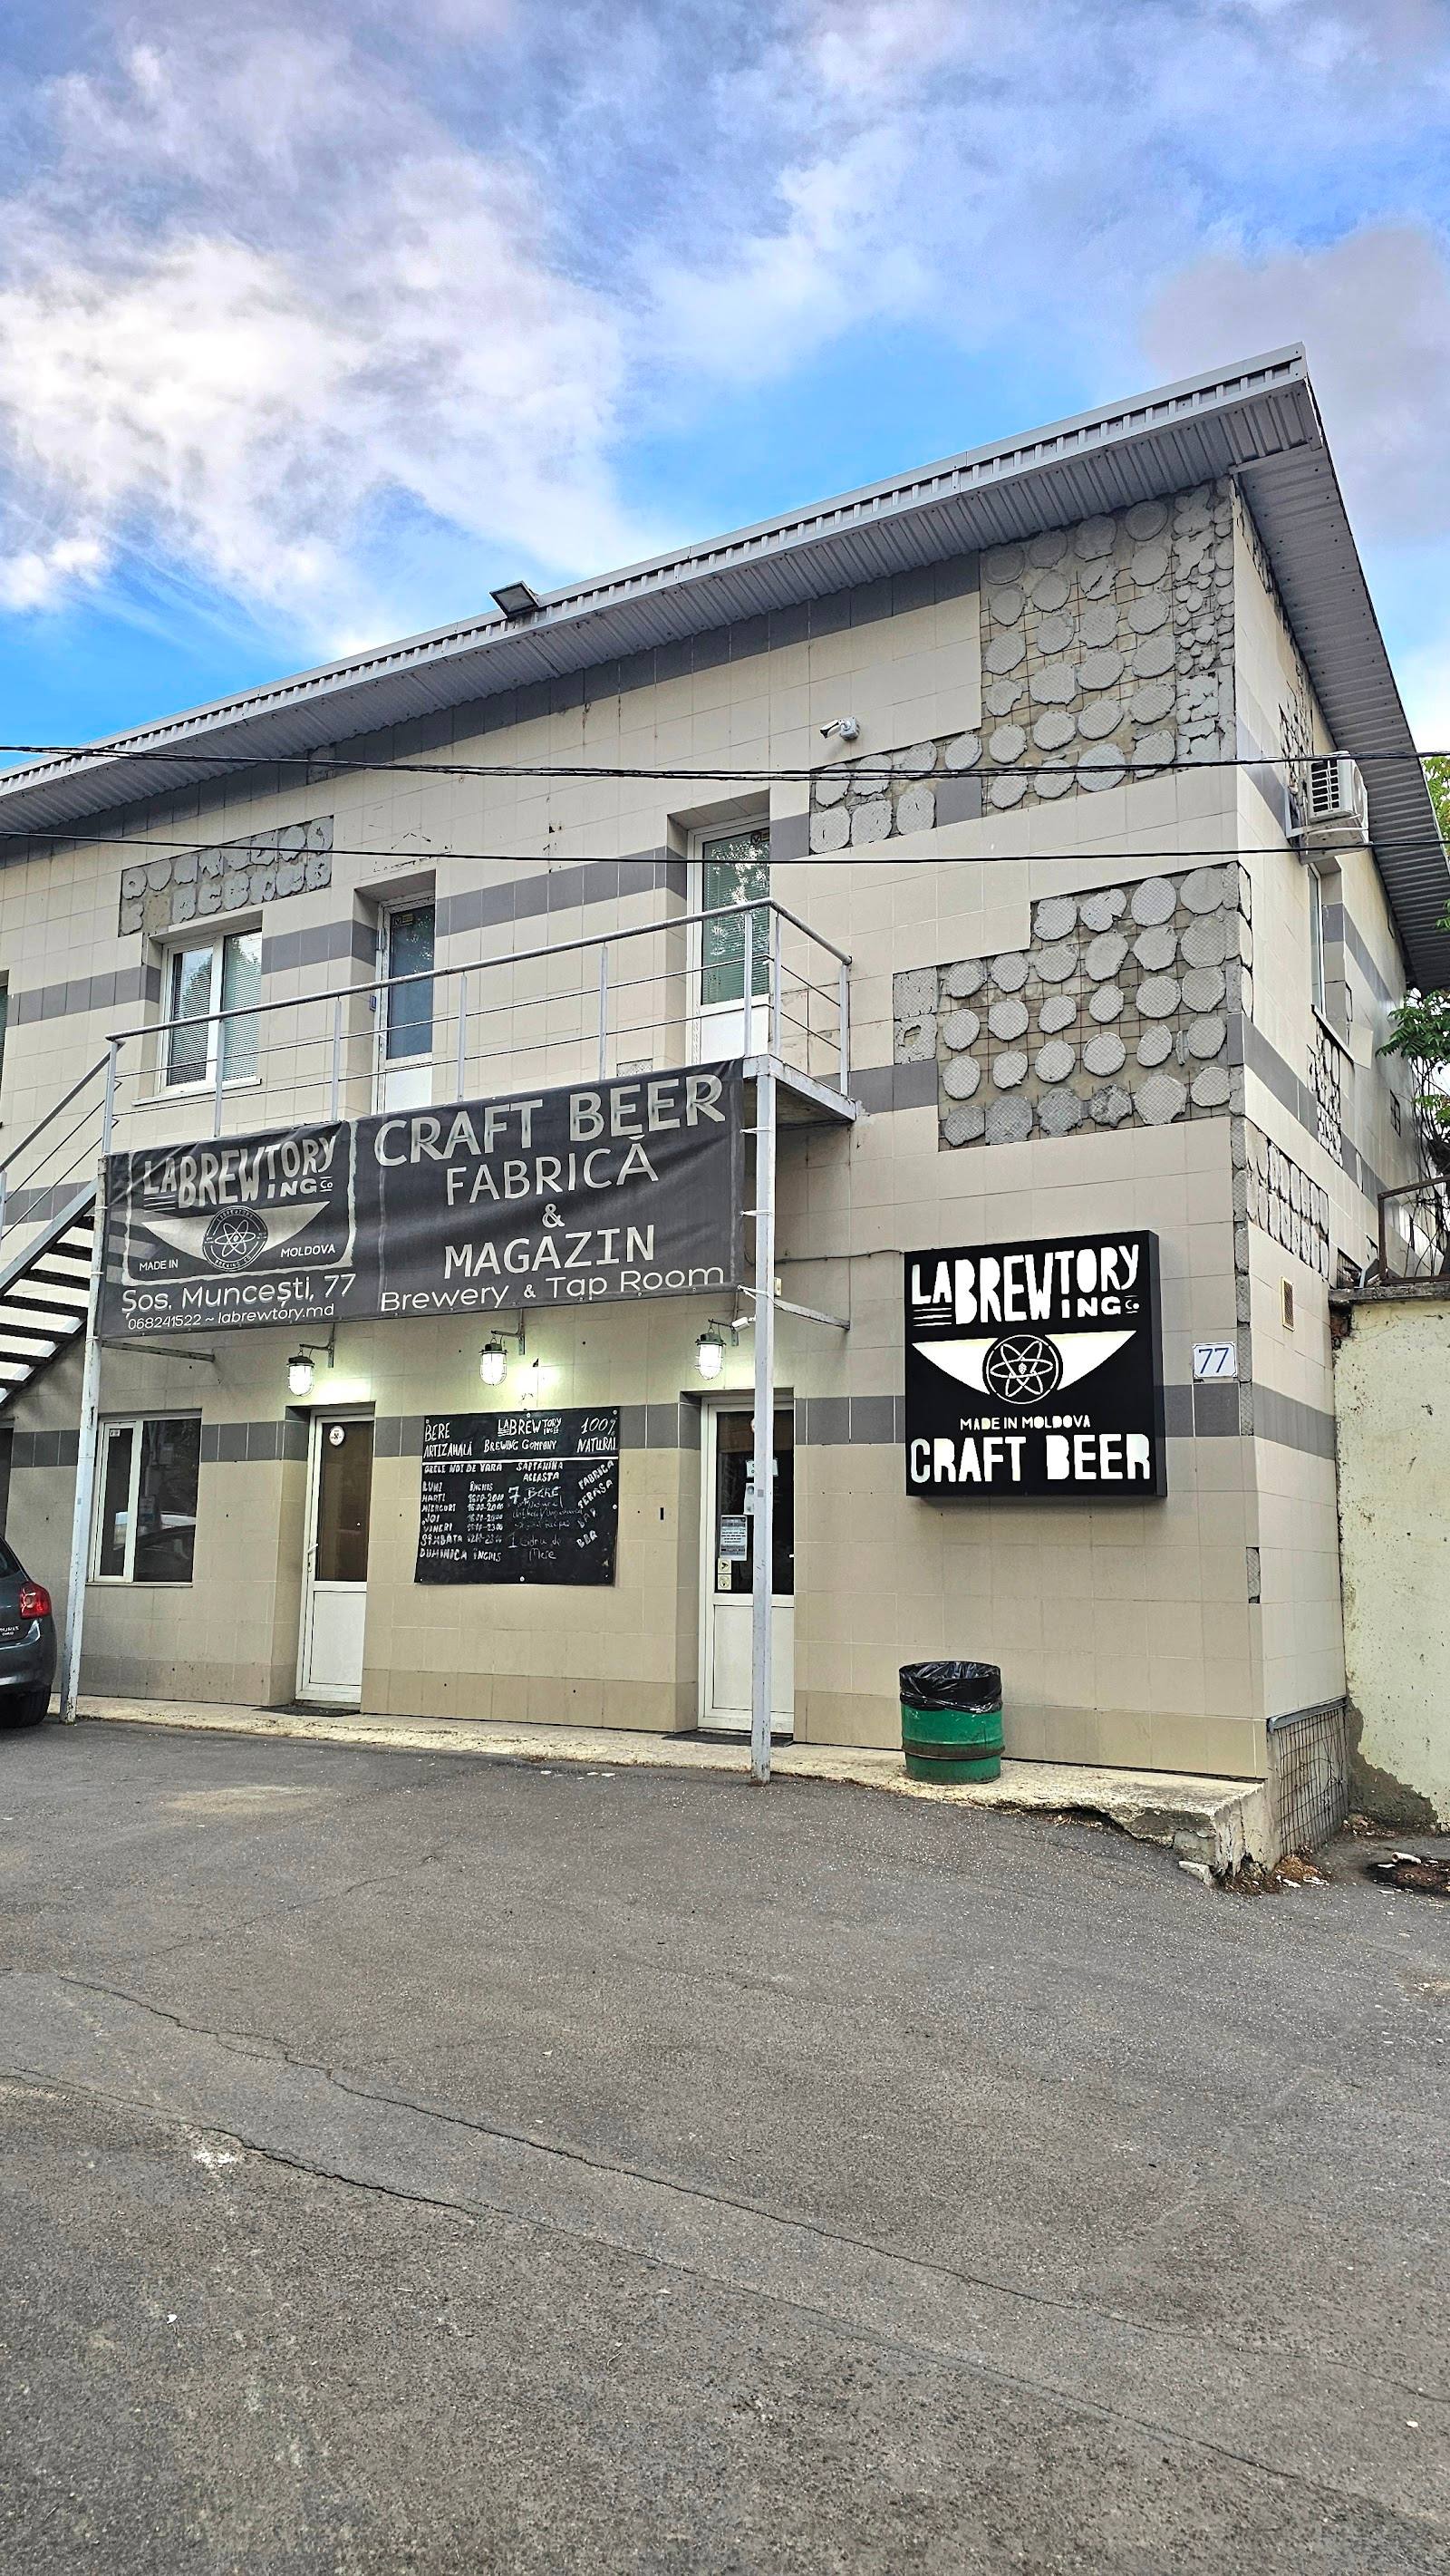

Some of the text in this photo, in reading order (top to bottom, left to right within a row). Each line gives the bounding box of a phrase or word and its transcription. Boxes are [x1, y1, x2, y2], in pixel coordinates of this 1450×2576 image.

[374, 1074, 726, 1167] CRAFT BEER
[447, 1134, 659, 1206] FABRICĂ
[542, 1204, 565, 1229] &
[281, 1244, 335, 1257] MOLDOVA
[444, 1225, 654, 1279] MAGAZIN
[139, 1259, 179, 1271] MADE IN
[181, 1276, 314, 1309] Muncești,
[324, 1273, 356, 1298] 77
[381, 1266, 724, 1313] Brewery & Tap Room
[128, 1313, 201, 1331] 068241522
[218, 1303, 334, 1325] labrewtory.md
[1198, 1348, 1230, 1375] 77
[425, 1422, 450, 1442] BERE
[581, 1417, 616, 1436] 100%
[960, 1415, 1091, 1431] MADE IN MOLDOVA
[576, 1437, 616, 1453] NATURAL
[910, 1434, 1151, 1484] CRAFT BEER
[508, 1486, 521, 1505] 7
